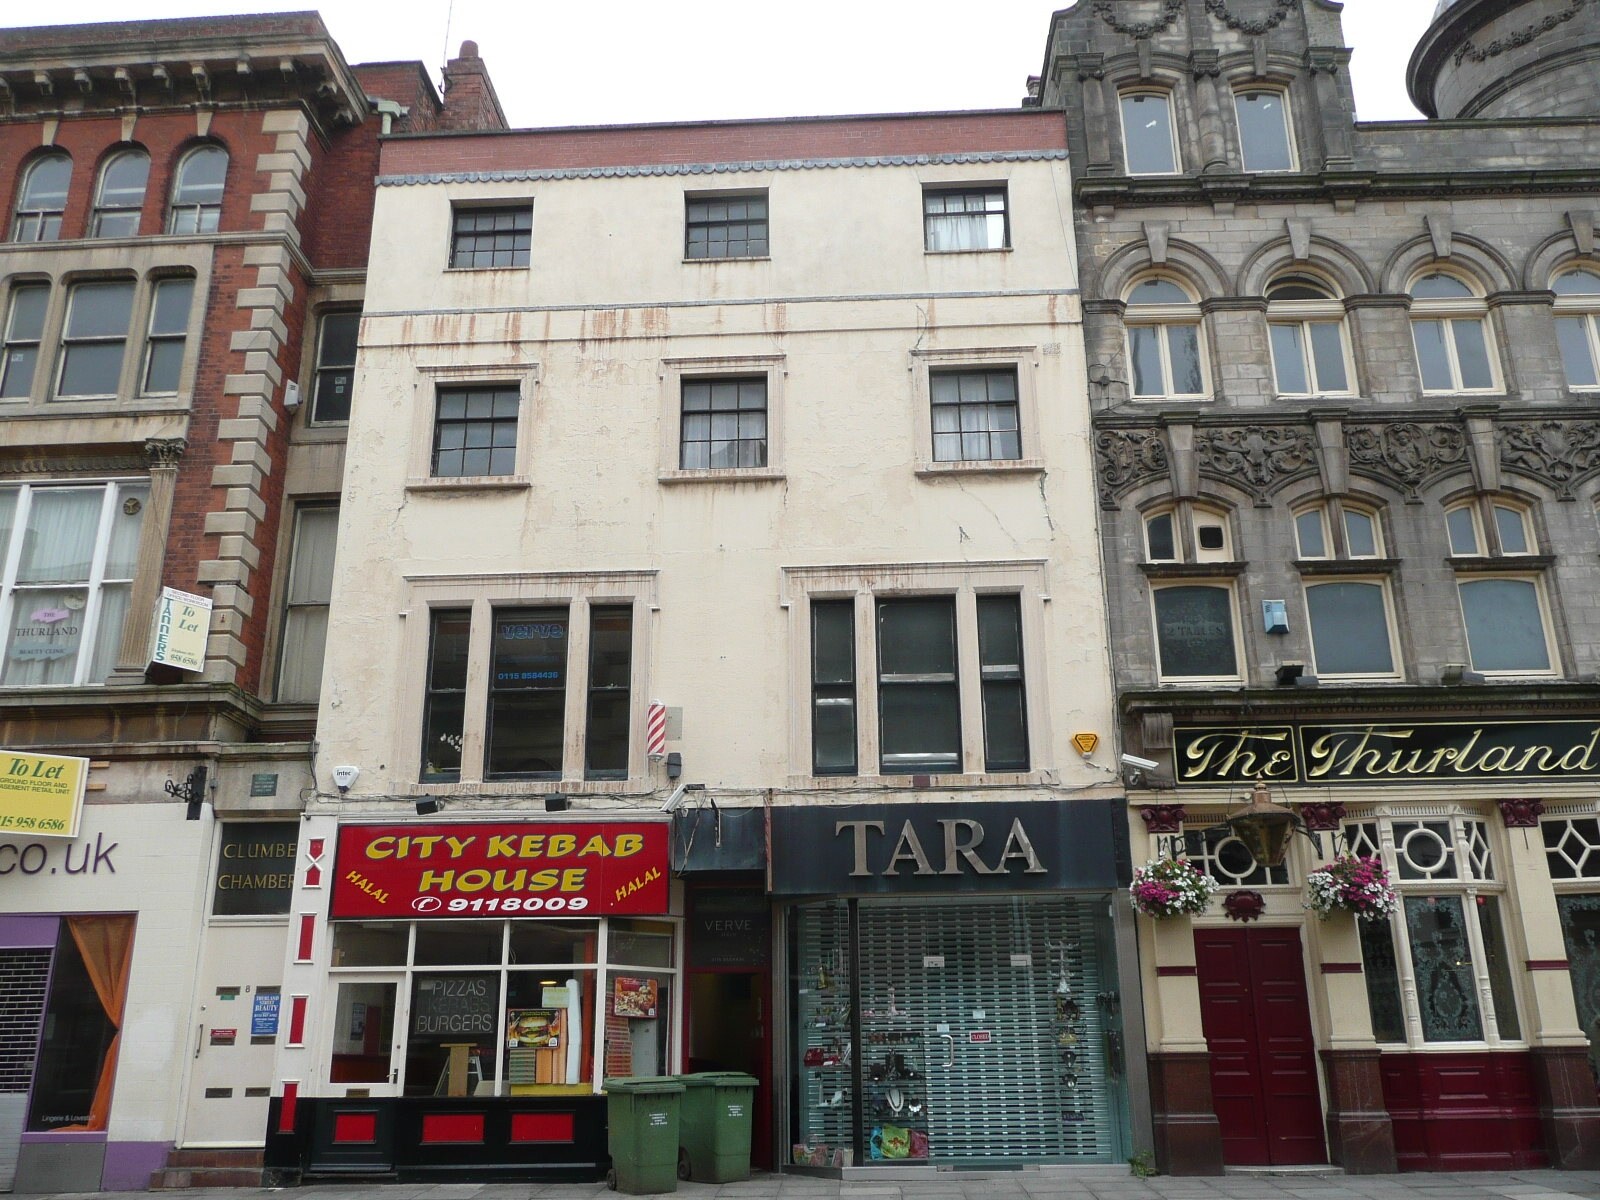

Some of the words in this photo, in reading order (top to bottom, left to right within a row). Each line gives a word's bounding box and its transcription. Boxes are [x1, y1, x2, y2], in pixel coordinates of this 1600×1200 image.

[182, 606, 195, 618] To
[16, 626, 78, 637] THURLAND
[179, 620, 198, 632] Let
[1184, 730, 1292, 778] The
[1308, 726, 1600, 777] Thurland
[8, 758, 29, 776] To
[32, 760, 64, 779] Let
[336, 769, 352, 777] intec
[30, 780, 53, 788] FLOOR
[31, 786, 54, 794] RETAIL
[15, 816, 37, 829] 958
[38, 818, 65, 831] 6586
[365, 835, 476, 860] CITY
[487, 834, 644, 859] KEBAB
[835, 817, 1048, 876] TARA
[346, 870, 390, 905] HALAL
[419, 868, 589, 893] HOUSE
[614, 866, 662, 902] HALAL
[447, 897, 589, 912] 9118009
[704, 920, 752, 931] VERVE
[432, 980, 486, 997] PIZZAS
[255, 1004, 278, 1012] BEAUTY
[417, 1014, 492, 1032] BURGERS
